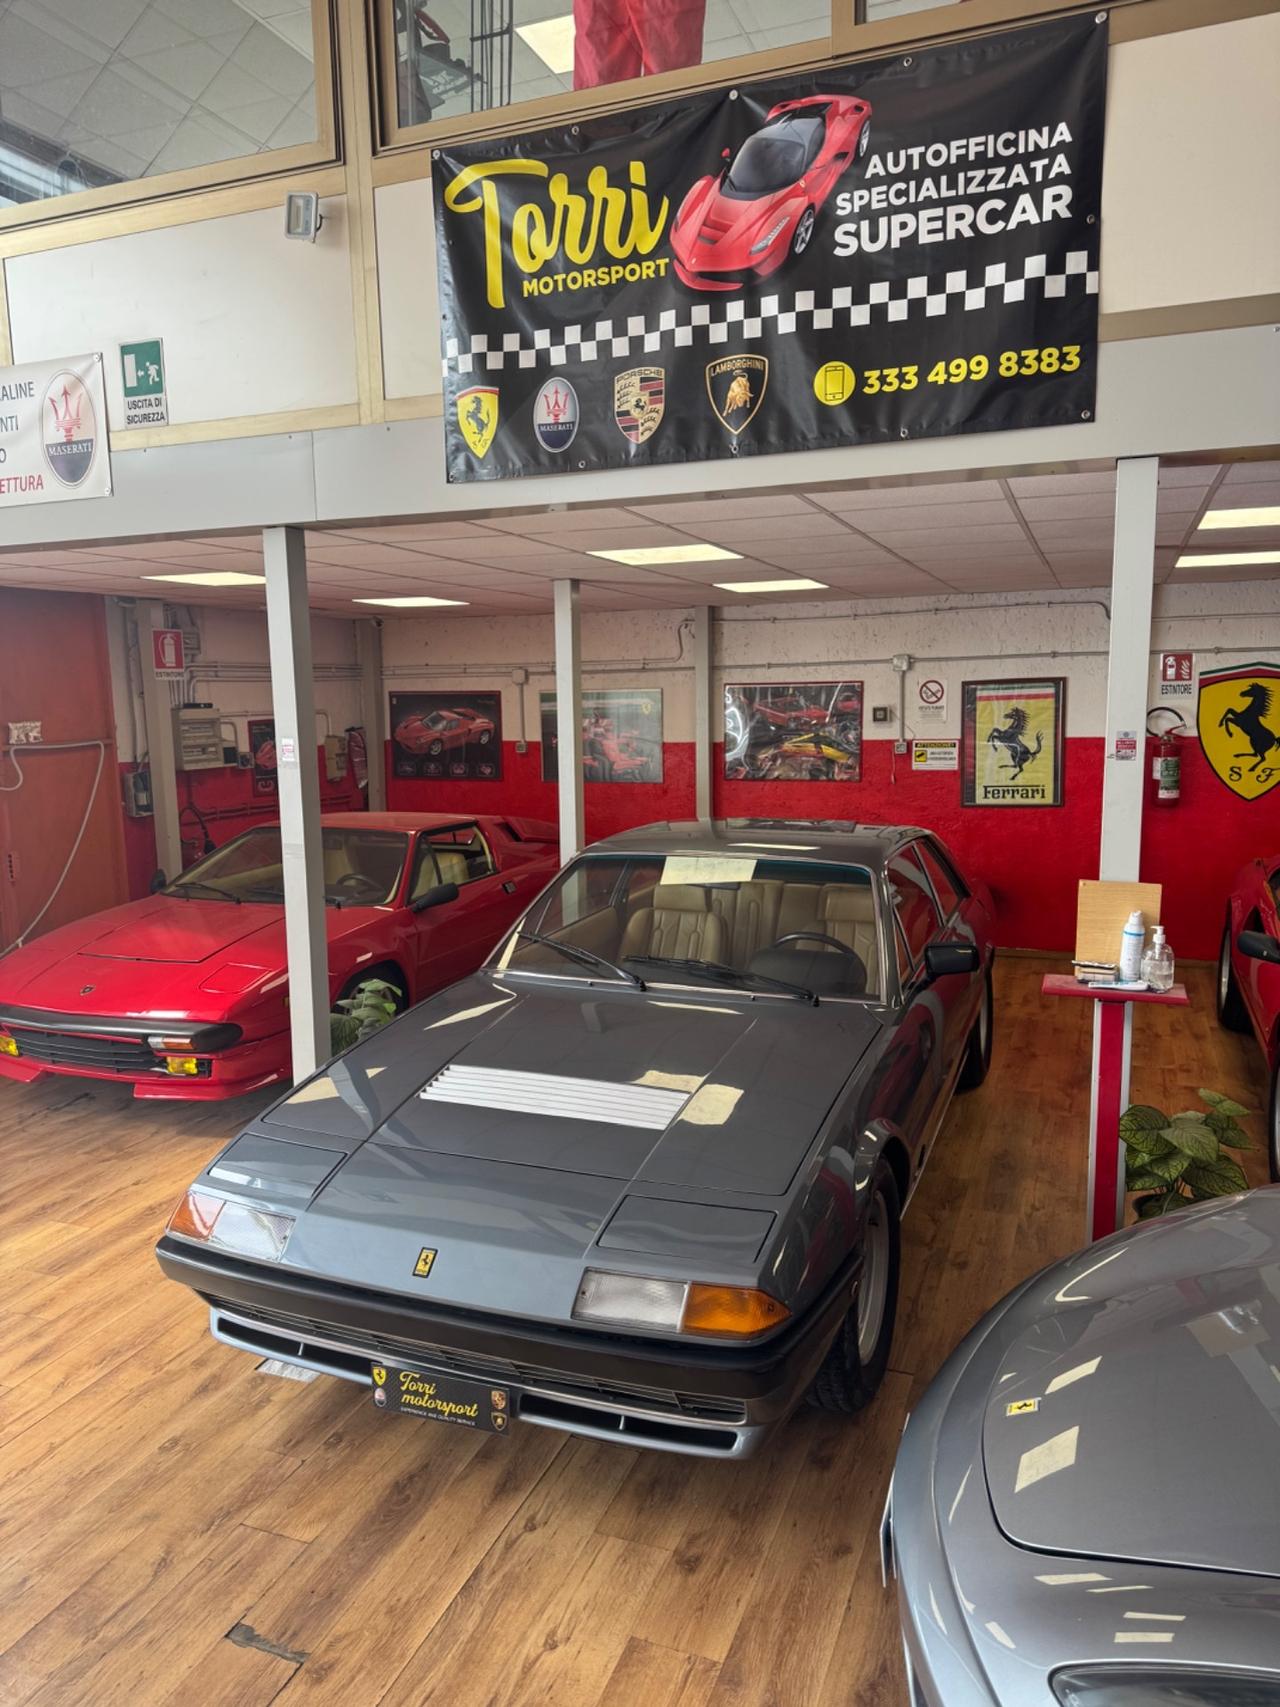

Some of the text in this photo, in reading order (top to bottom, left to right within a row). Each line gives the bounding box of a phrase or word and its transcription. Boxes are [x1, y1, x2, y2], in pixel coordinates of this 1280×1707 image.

[865, 121, 1073, 179] AUTOFFICINA
[836, 153, 1072, 216] SPECIALIZZATA
[833, 184, 1073, 257] SUPERCAR
[444, 158, 670, 309] Torri
[522, 258, 670, 298] MOTORSPORT
[616, 368, 663, 382] PORSCHE
[710, 358, 764, 376] LAMBORGHINI
[862, 345, 1081, 395] 333 499 8383
[0, 381, 35, 401] ALINE
[127, 397, 162, 410] USCITA DI
[127, 411, 165, 425] SICUREZZA
[539, 423, 573, 432] MASERATI
[48, 441, 92, 456] MASERATI
[1161, 684, 1192, 695] ESTINTORE
[1229, 766, 1242, 782] S
[982, 785, 1045, 799] Ferrari
[400, 1371, 436, 1395] Torri
[401, 1394, 478, 1417] motorsport
